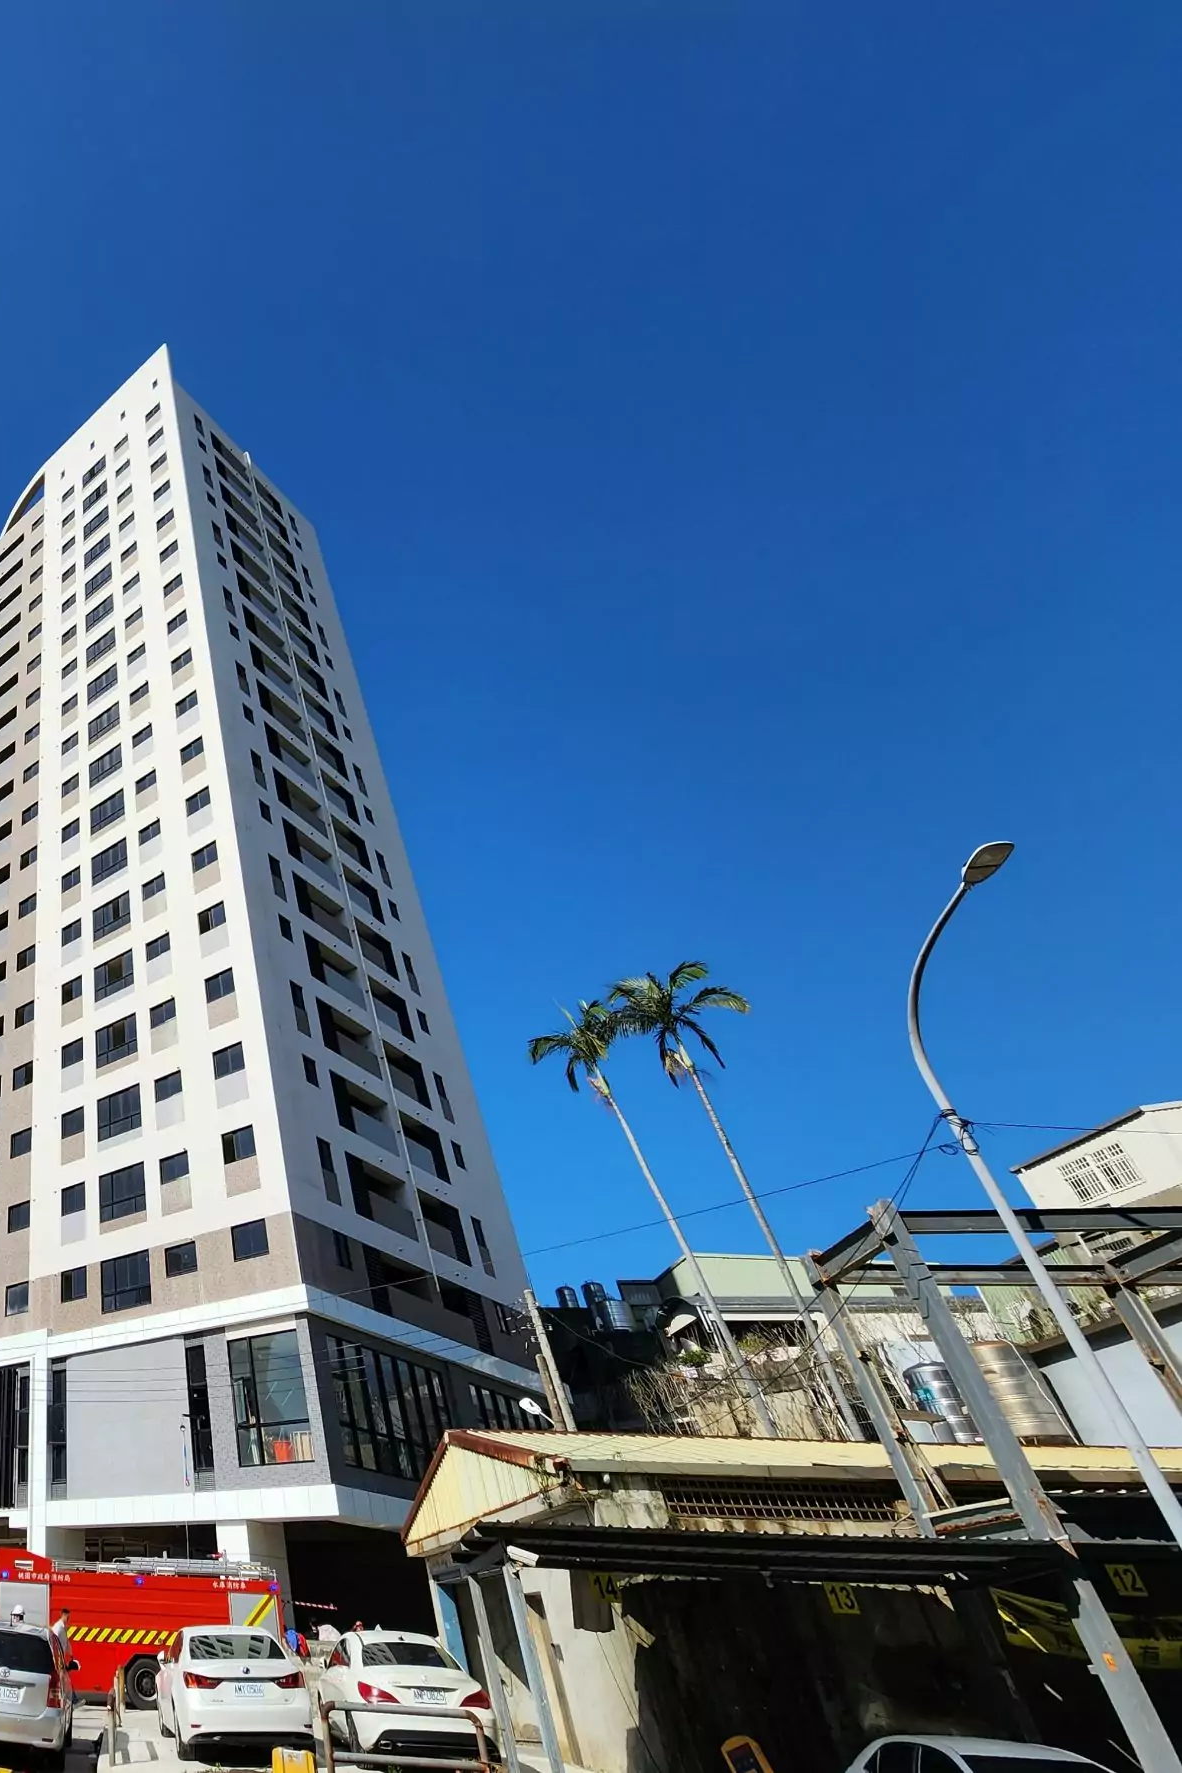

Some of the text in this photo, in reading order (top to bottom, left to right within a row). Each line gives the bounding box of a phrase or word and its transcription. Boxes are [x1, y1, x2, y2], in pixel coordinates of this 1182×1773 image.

[593, 1575, 618, 1600] 14
[1113, 1568, 1144, 1593] 12
[829, 1585, 856, 1610] 13
